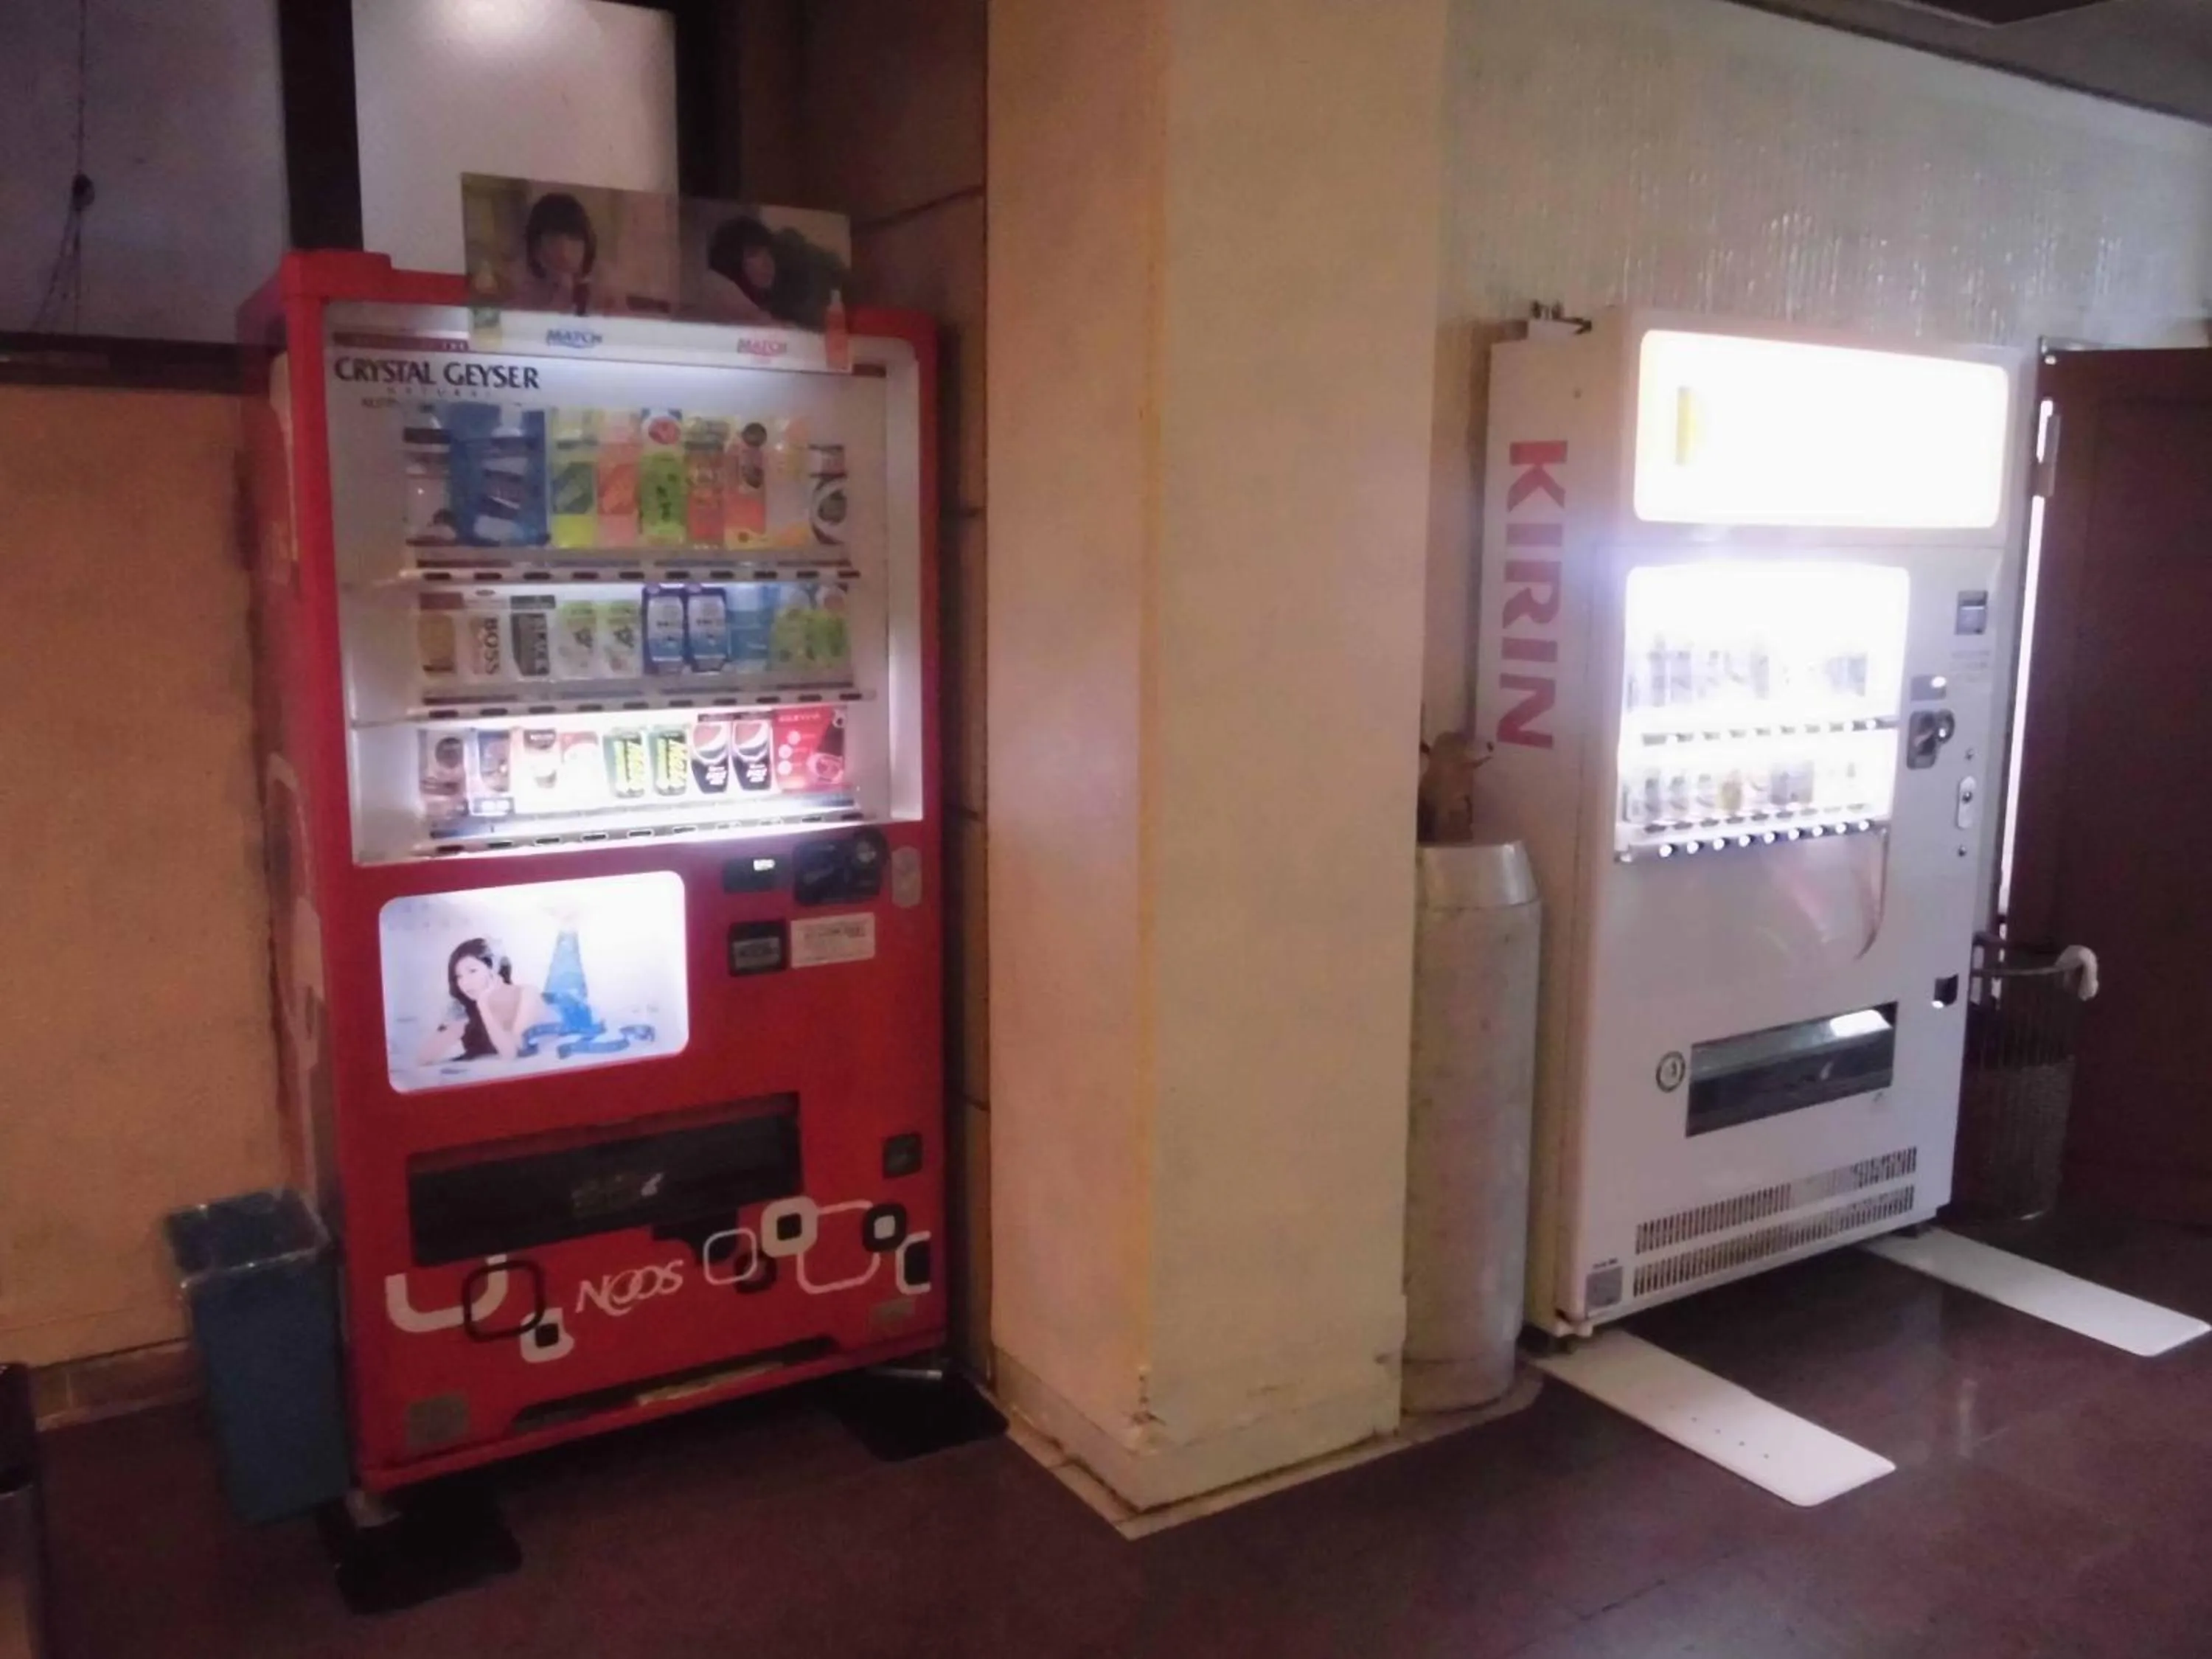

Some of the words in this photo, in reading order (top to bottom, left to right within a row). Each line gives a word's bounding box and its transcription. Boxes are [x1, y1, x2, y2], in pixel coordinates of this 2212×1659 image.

[334, 356, 437, 385] CRYSTAL
[443, 361, 540, 389] GEYSER
[1496, 440, 1568, 749] KIRIN
